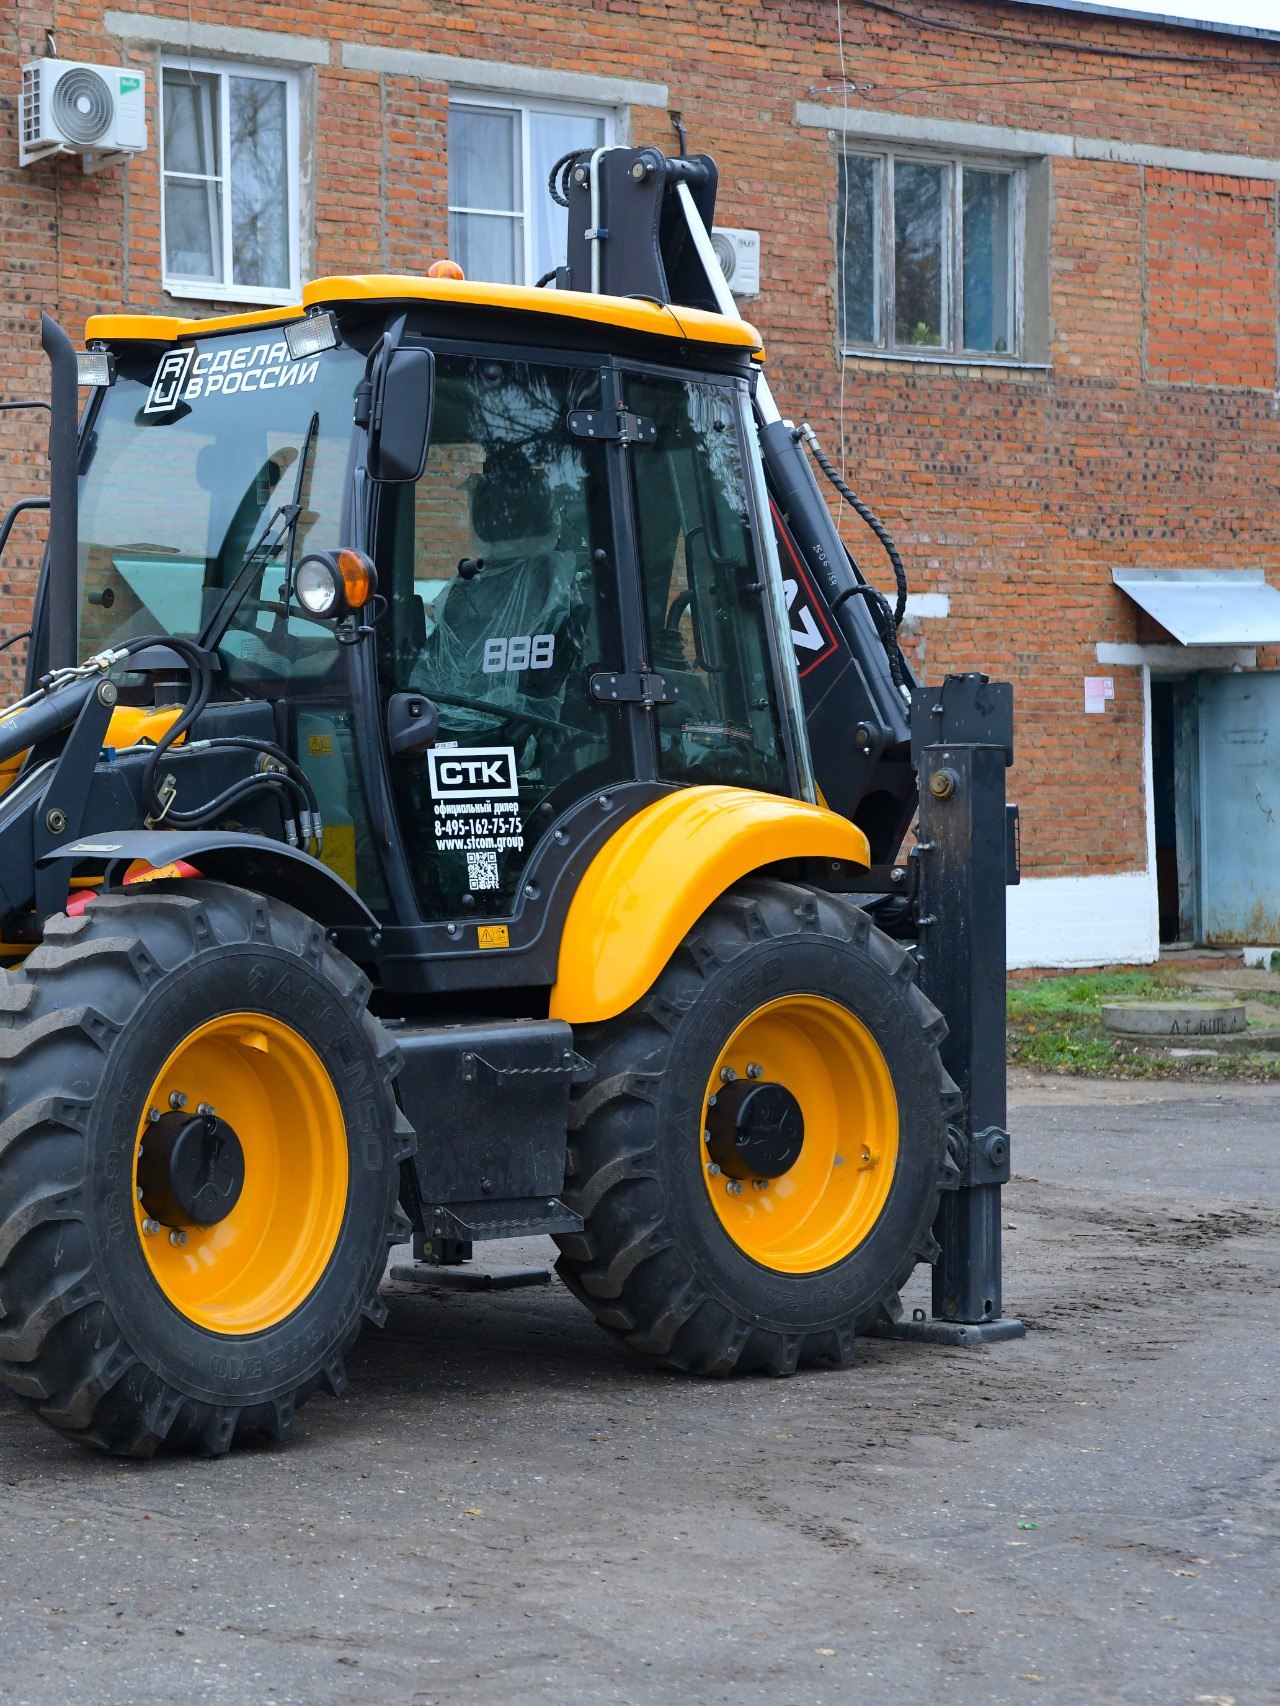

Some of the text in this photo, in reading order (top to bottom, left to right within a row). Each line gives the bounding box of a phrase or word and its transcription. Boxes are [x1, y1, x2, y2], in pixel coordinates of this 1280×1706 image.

[192, 341, 322, 375] СДЕЛА
[184, 360, 320, 400] В РОССИИ
[482, 633, 555, 673] 888
[440, 760, 506, 785] СТК
[434, 800, 519, 818] официальный дилер
[434, 818, 522, 836] 8-495-162-75-75
[436, 835, 524, 852] www.stcom.group
